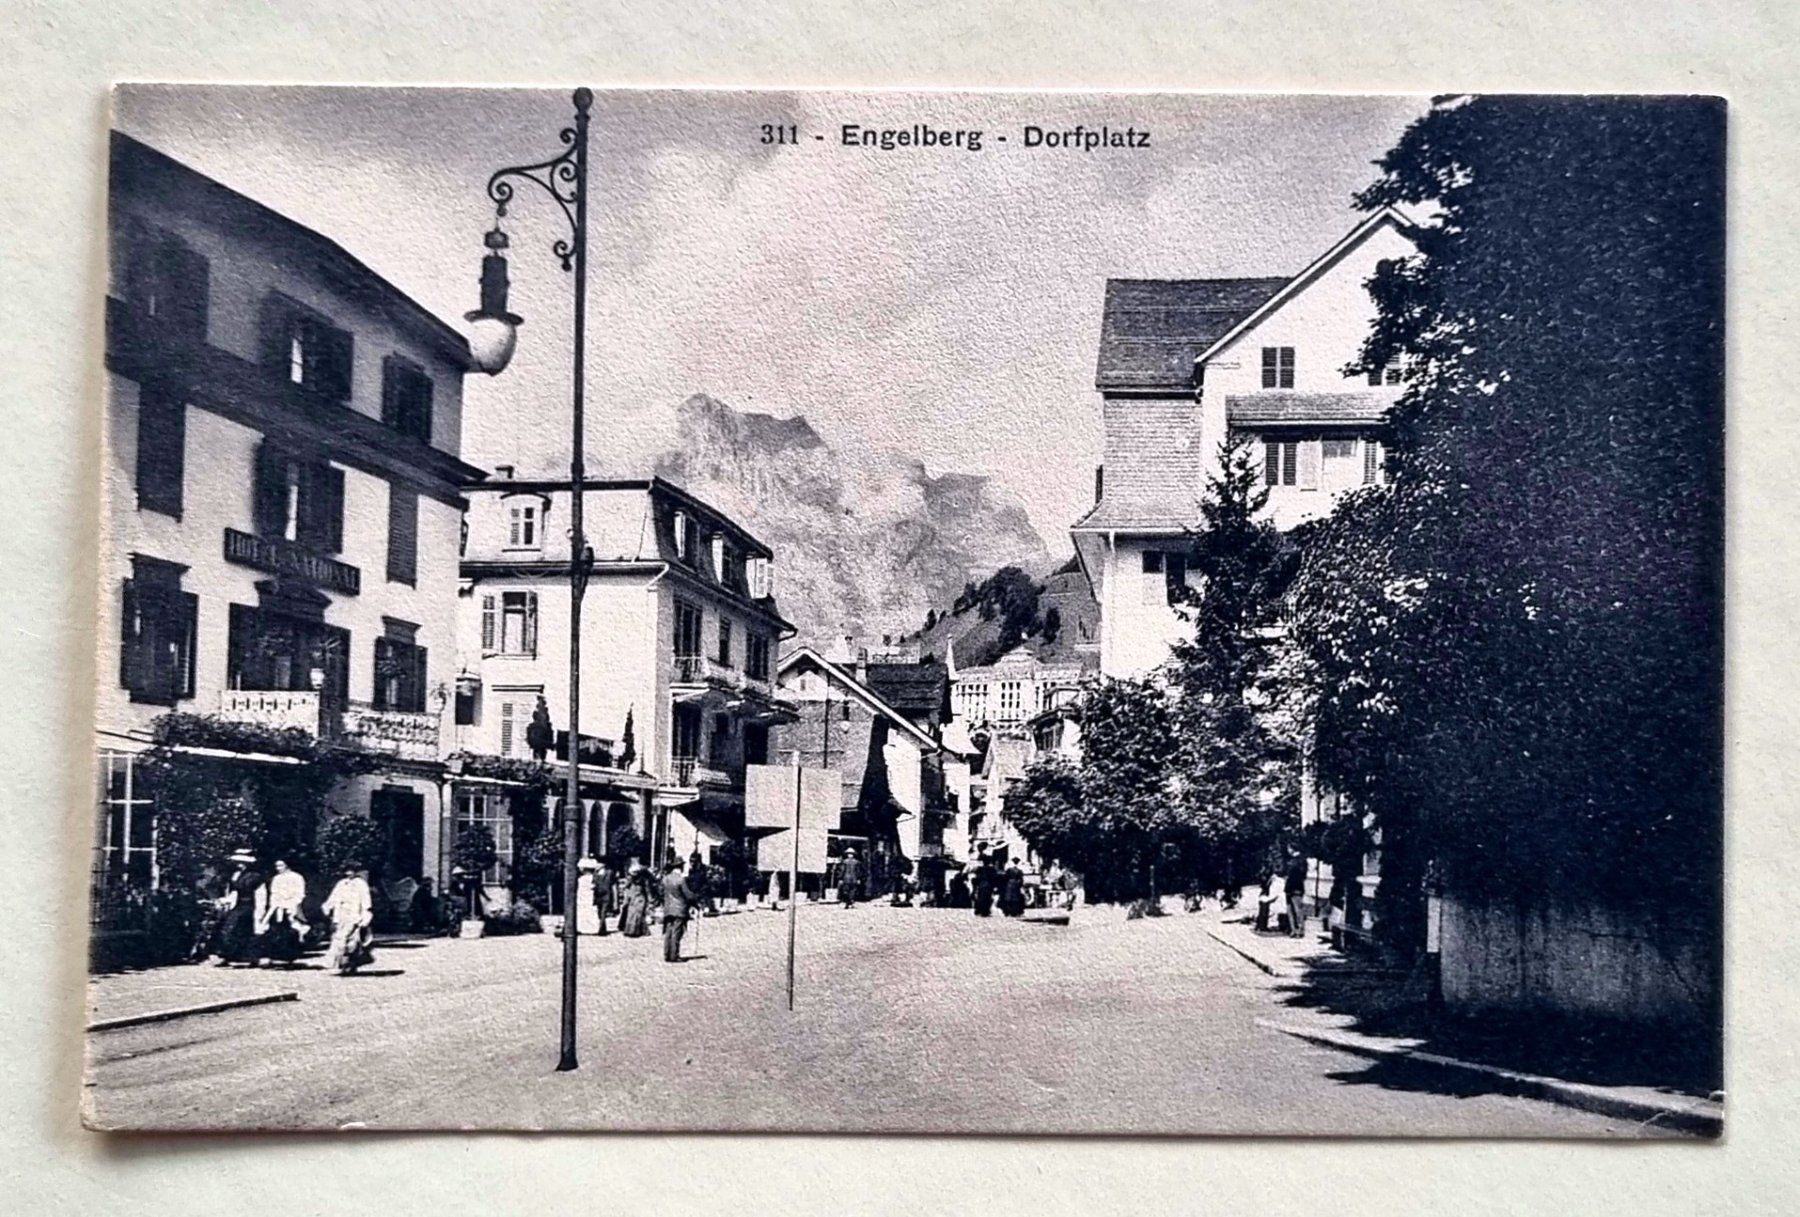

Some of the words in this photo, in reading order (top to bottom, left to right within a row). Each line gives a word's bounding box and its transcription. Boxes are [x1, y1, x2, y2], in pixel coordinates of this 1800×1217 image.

[760, 123, 799, 145] 311
[841, 124, 983, 151] Engelberg
[1024, 125, 1151, 152] Dorfplatz
